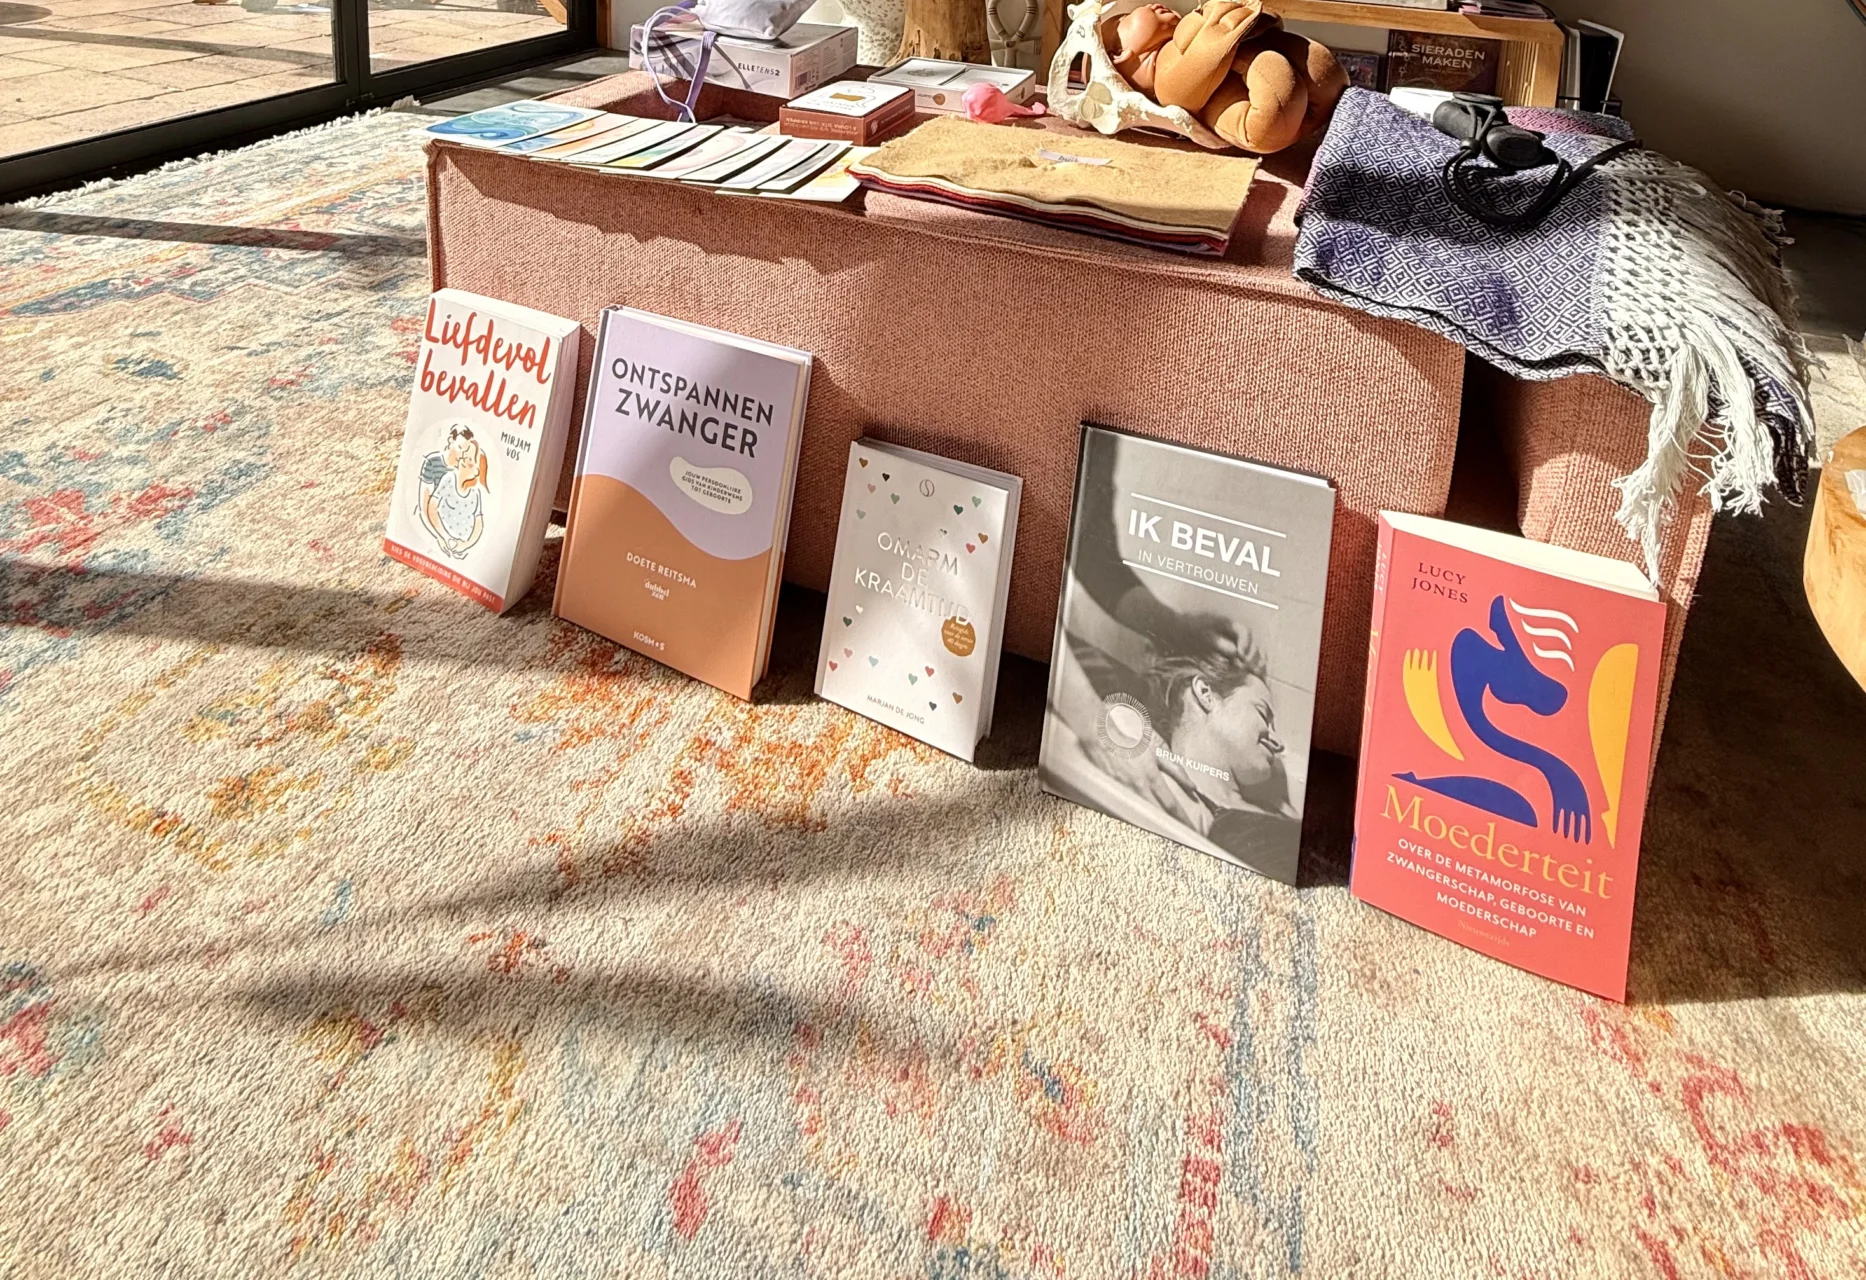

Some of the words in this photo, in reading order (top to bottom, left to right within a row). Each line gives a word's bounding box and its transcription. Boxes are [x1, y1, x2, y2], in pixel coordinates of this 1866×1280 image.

[1412, 44, 1486, 60] SIERADEN
[1422, 56, 1472, 70] MAKEN
[425, 298, 552, 384] Liefdevol
[420, 348, 536, 430] bevallen
[612, 358, 774, 426] ONTSPANNEN
[615, 388, 758, 458] ZWANGER
[500, 432, 531, 452] MIRJAM
[506, 447, 520, 461] VOS
[682, 475, 694, 484] GIDS
[696, 480, 706, 488] VAN
[707, 485, 742, 502] KINDERWENS
[685, 470, 700, 480] JOUW
[702, 476, 742, 494] PERSOONLIJKE
[692, 484, 702, 492] TOT
[702, 489, 732, 504] GEBOORTE
[878, 532, 958, 576] OMARM
[1128, 508, 1162, 544] IK
[1171, 520, 1280, 578] BEVAL
[626, 552, 656, 572] DOETE
[658, 564, 696, 588] REITSMA
[902, 562, 928, 588] DE
[1138, 548, 1153, 564] IN
[1157, 554, 1260, 595] VERTROUWEN
[1418, 562, 1466, 585] LUCY
[855, 567, 970, 626] KRAAMTIJD
[1412, 578, 1468, 604] JONES
[867, 694, 894, 712] MARJAN
[895, 706, 905, 716] DE
[906, 712, 925, 724] JONG
[1156, 746, 1184, 765] BRUN
[1186, 758, 1230, 782] KUIPERS
[1380, 783, 1614, 900] Moederteit
[1386, 851, 1497, 908] ZWANGERSCHAP,
[1500, 898, 1573, 934] GEBOORTE
[1576, 923, 1596, 940] EN
[1398, 838, 1432, 861] OVER
[1435, 853, 1452, 868] DE
[1455, 860, 1556, 907] METAMORFOSE
[1559, 898, 1588, 918] VAN
[1436, 890, 1538, 938] MOEDERSCHAP
[1457, 919, 1510, 949] Nieuwezijds
